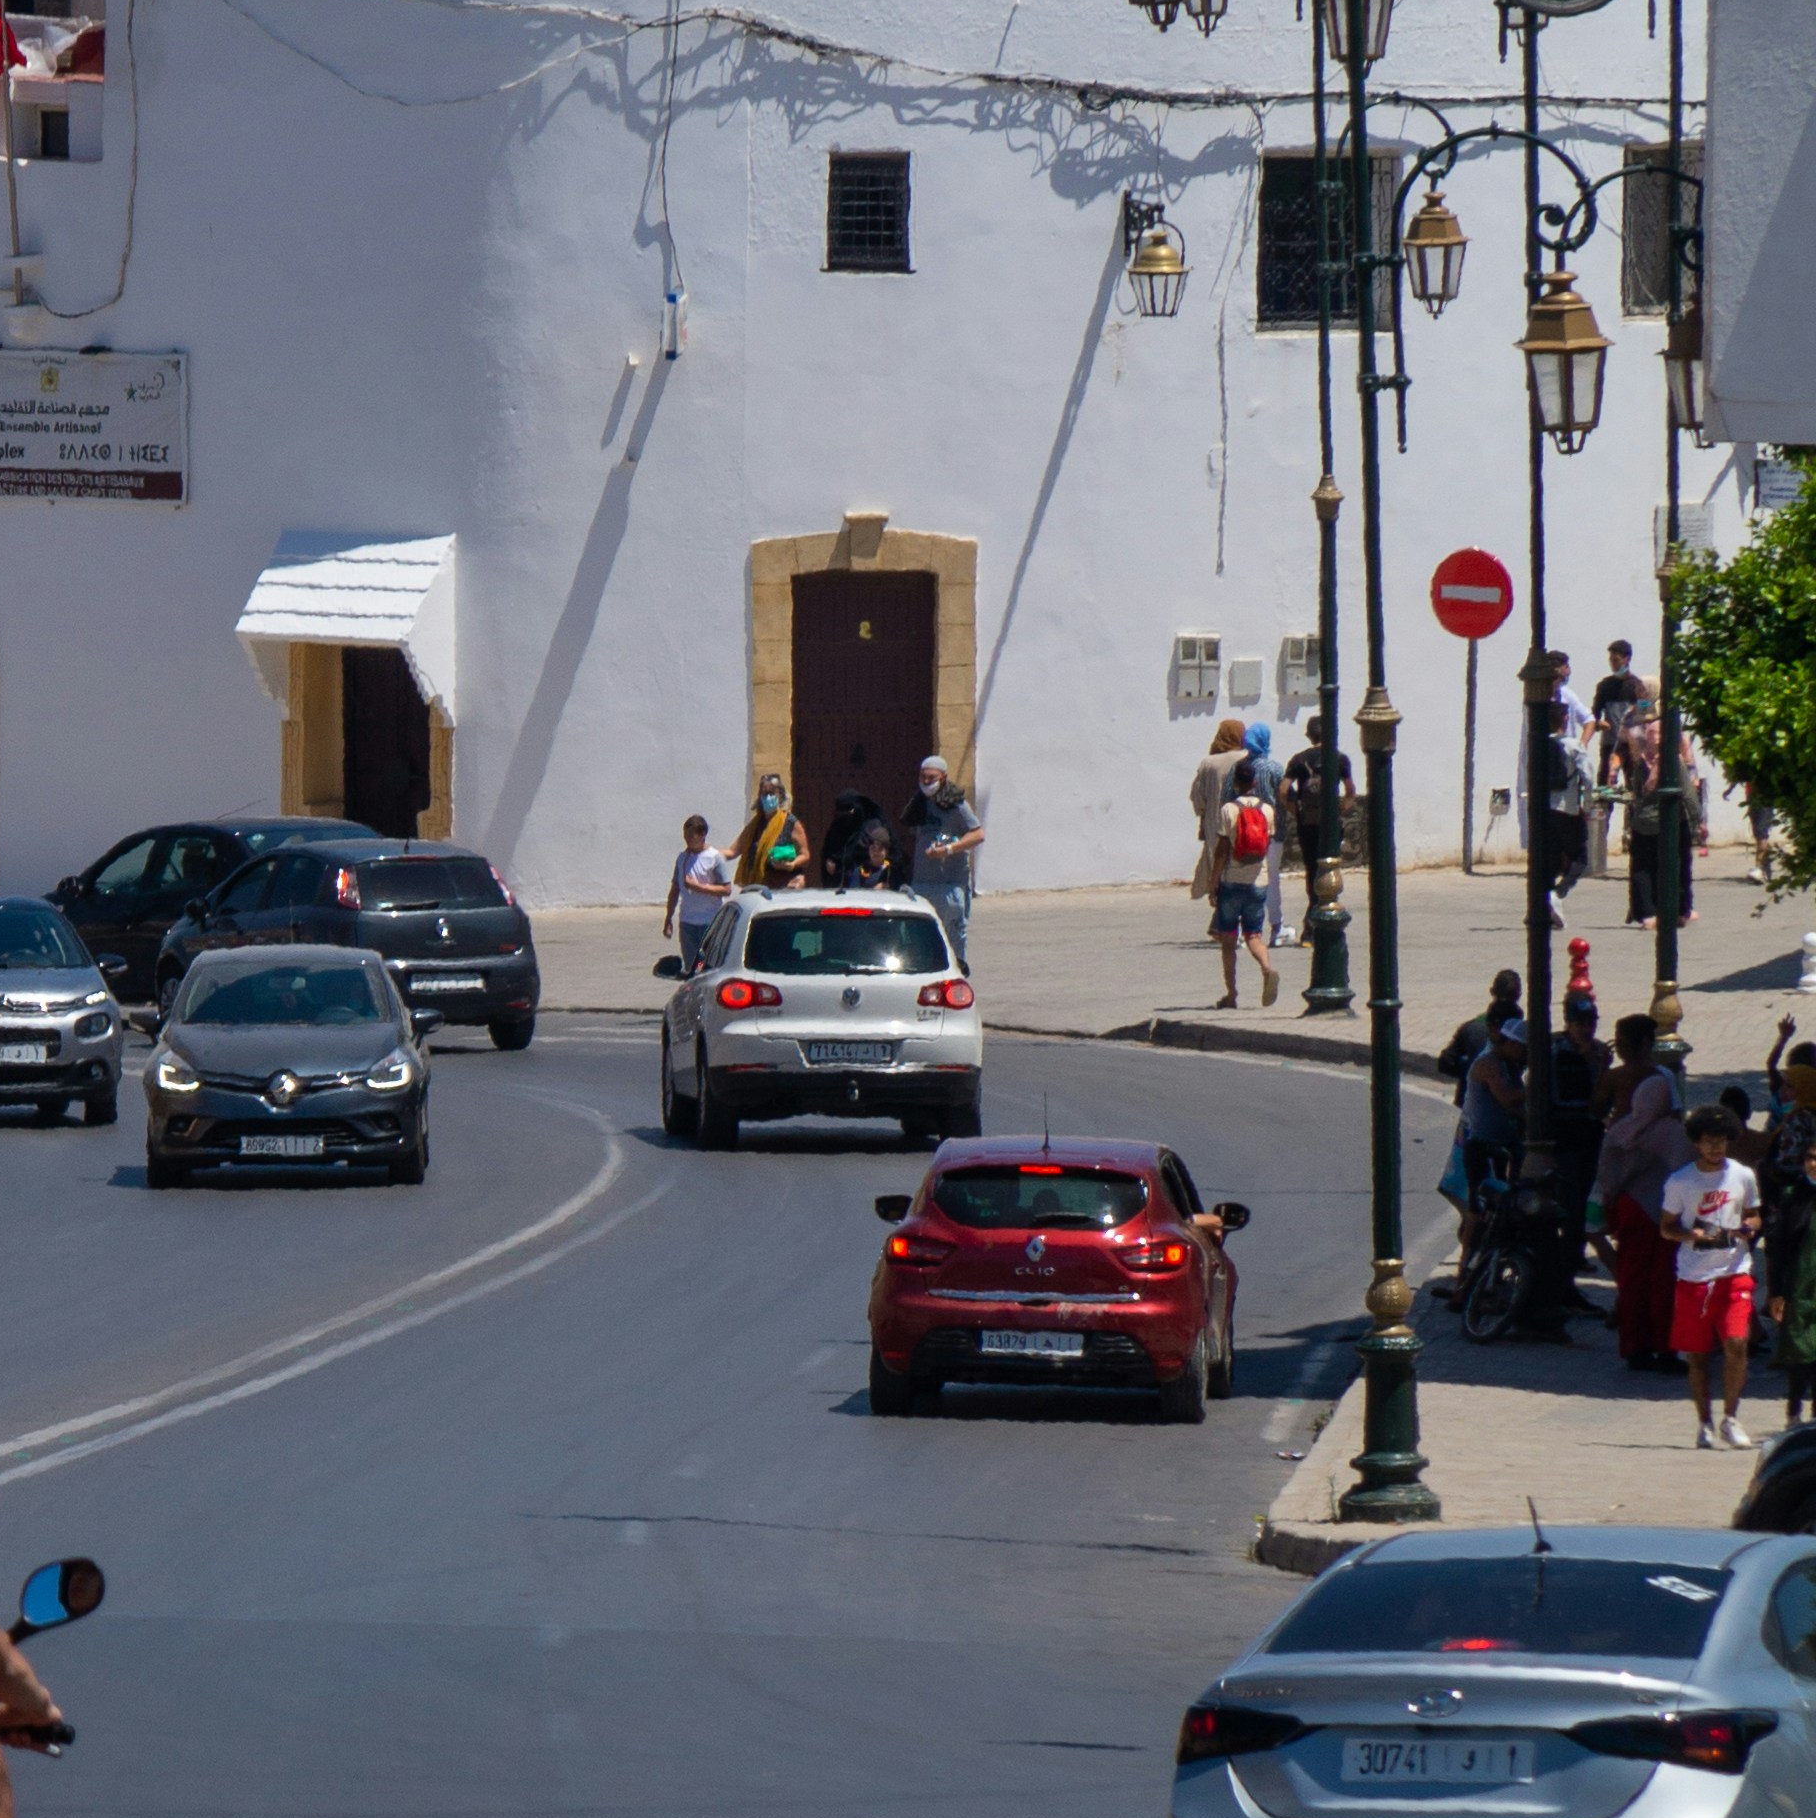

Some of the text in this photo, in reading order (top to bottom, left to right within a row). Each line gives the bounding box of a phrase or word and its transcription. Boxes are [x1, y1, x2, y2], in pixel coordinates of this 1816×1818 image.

[0, 421, 102, 434] Ensemble Artisanal
[1014, 1266, 1056, 1276] CLIO
[1358, 1743, 1427, 1775] 30741
